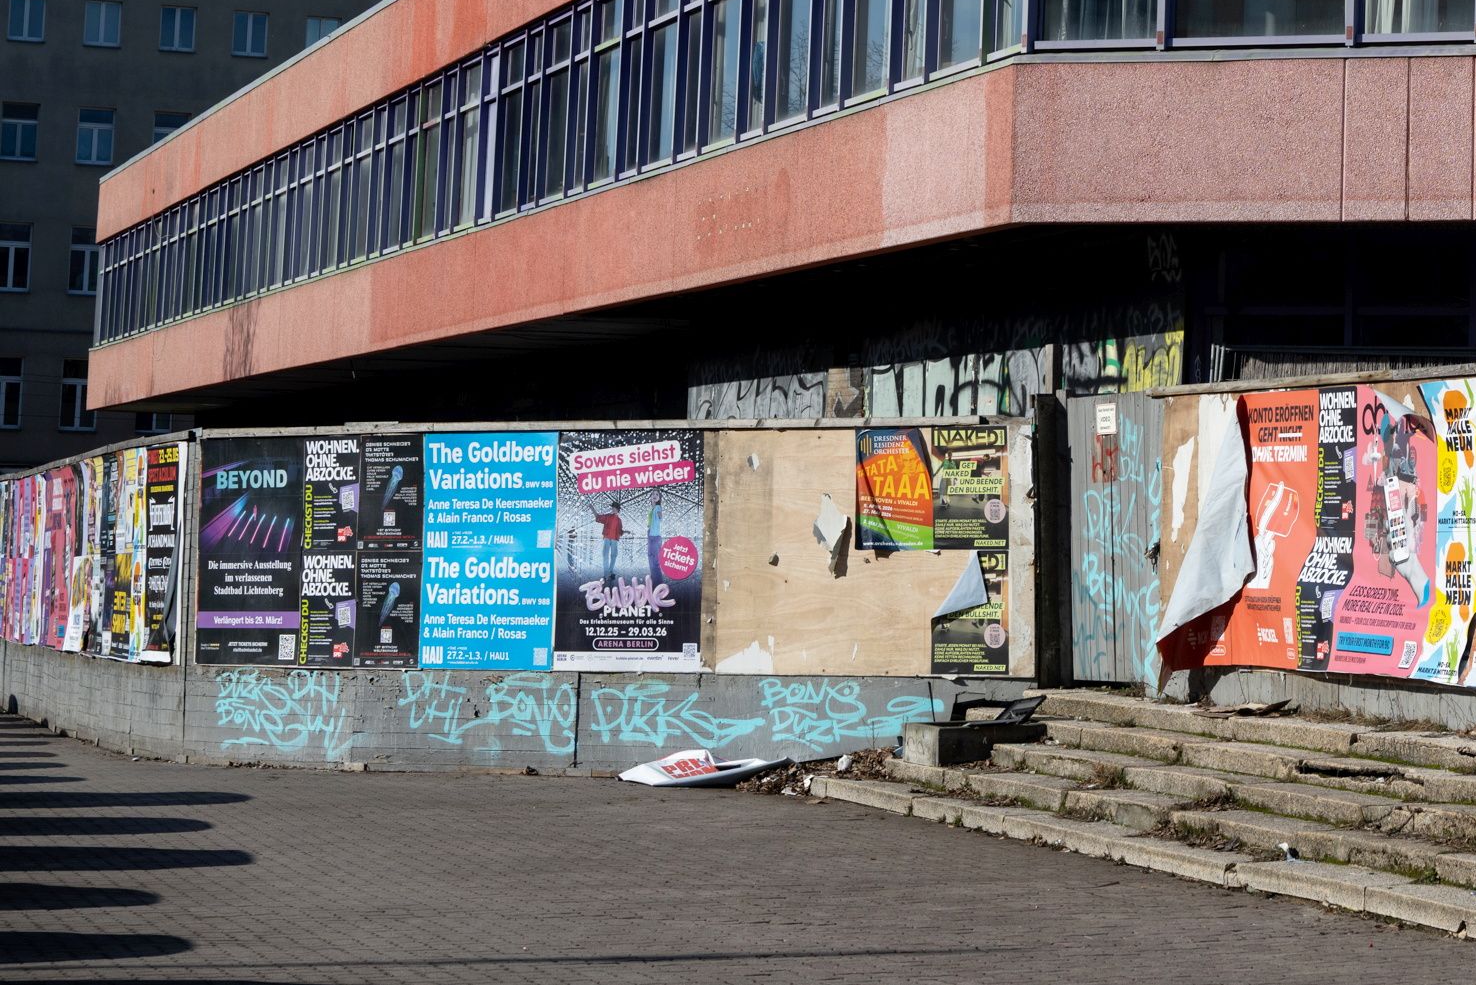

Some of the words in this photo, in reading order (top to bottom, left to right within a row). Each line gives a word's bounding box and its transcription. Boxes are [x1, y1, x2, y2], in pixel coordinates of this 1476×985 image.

[1249, 408, 1273, 424] KONTO
[1275, 404, 1314, 423] ERÖFFNEN
[1258, 426, 1278, 443] GEHT
[306, 439, 360, 454] WOHNEN.
[429, 442, 463, 464] The
[468, 441, 554, 466] Goldberg
[1273, 445, 1308, 463] TERMIN!
[305, 454, 340, 468] OHNE.
[573, 452, 625, 471] Sowas
[629, 443, 676, 464] siehst
[216, 469, 288, 490] BEYOND
[305, 467, 356, 482] ABZOCKE.
[581, 475, 603, 491] du
[607, 471, 631, 488] nie
[635, 465, 691, 484] wieder
[428, 499, 451, 509] Anne
[452, 498, 480, 509] Teresa
[481, 498, 493, 508] De
[496, 498, 554, 509] Keersmaeker
[427, 530, 448, 549] HAU
[662, 548, 695, 566] Tickets
[208, 560, 218, 570] Die
[219, 560, 252, 570] immersive
[253, 560, 292, 572] Ausstellung
[1445, 560, 1472, 573] MARKT
[225, 573, 234, 582] im
[234, 573, 273, 583] verlassenen
[1445, 574, 1472, 589] HALLE
[213, 586, 242, 595] Stadtbad
[243, 586, 284, 597] Lichtenberg
[579, 574, 676, 613] Bubble
[1445, 590, 1471, 606] NEUN
[603, 605, 652, 617] PLANET
[585, 627, 619, 637] 12.12.25
[628, 627, 667, 637] 29.03.26
[597, 640, 625, 648] ARENA
[627, 640, 654, 648] BERLIN
